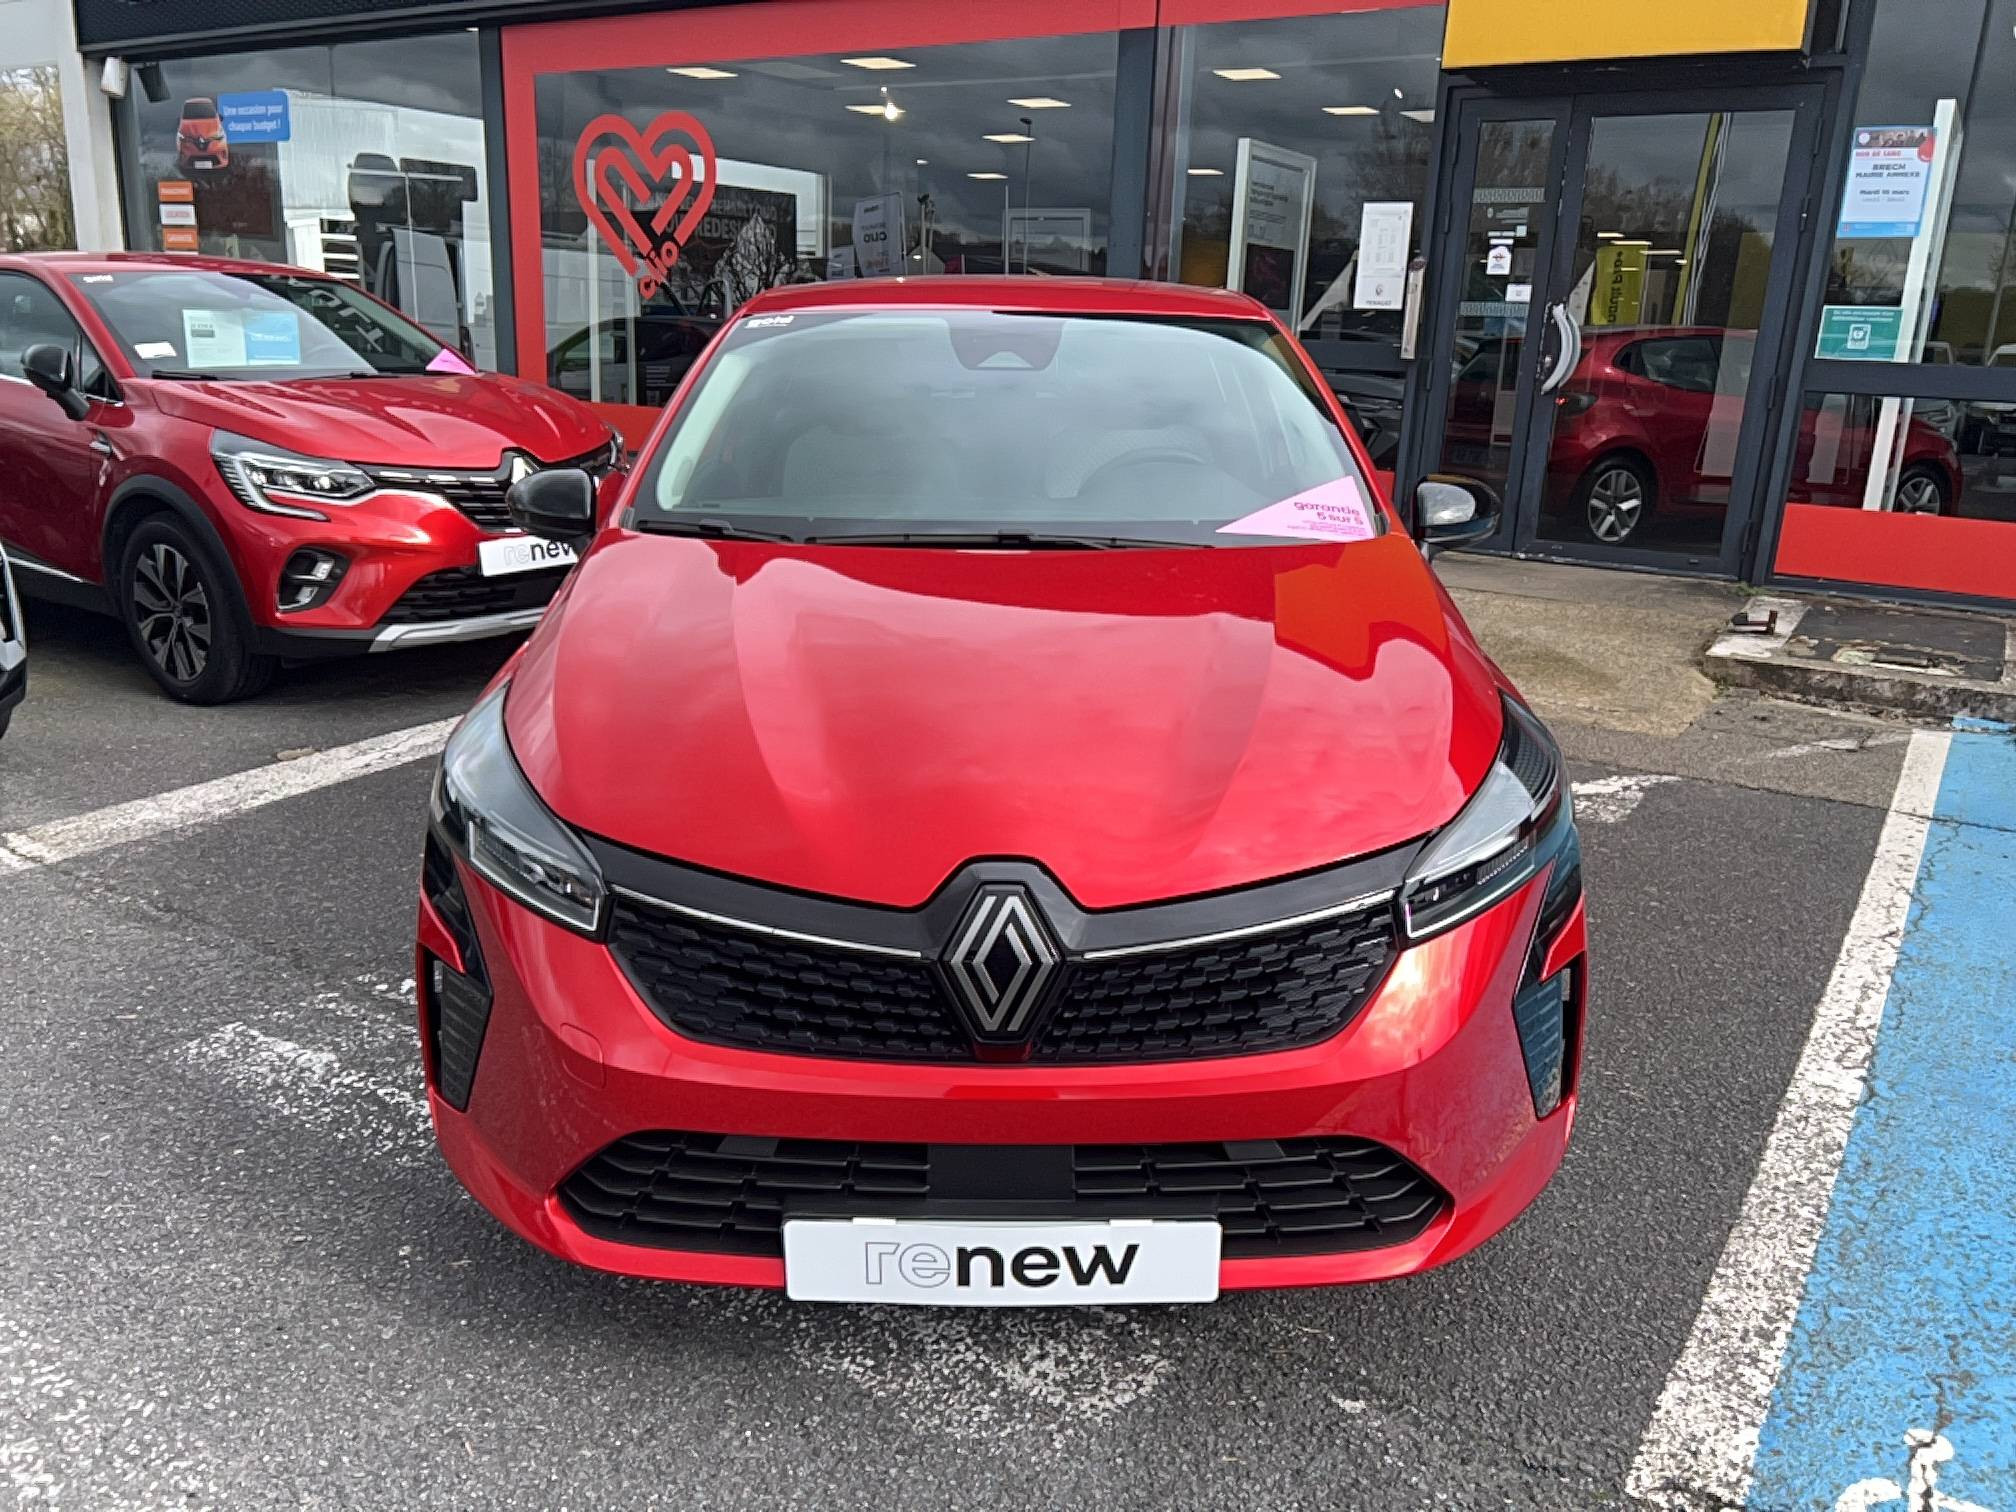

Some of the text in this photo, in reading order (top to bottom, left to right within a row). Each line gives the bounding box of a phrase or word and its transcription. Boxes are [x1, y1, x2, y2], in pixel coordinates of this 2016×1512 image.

[1872, 163, 1906, 171] BRECH
[1294, 501, 1360, 516] garantie
[1328, 513, 1351, 524] sur
[864, 1241, 1140, 1288] renew
